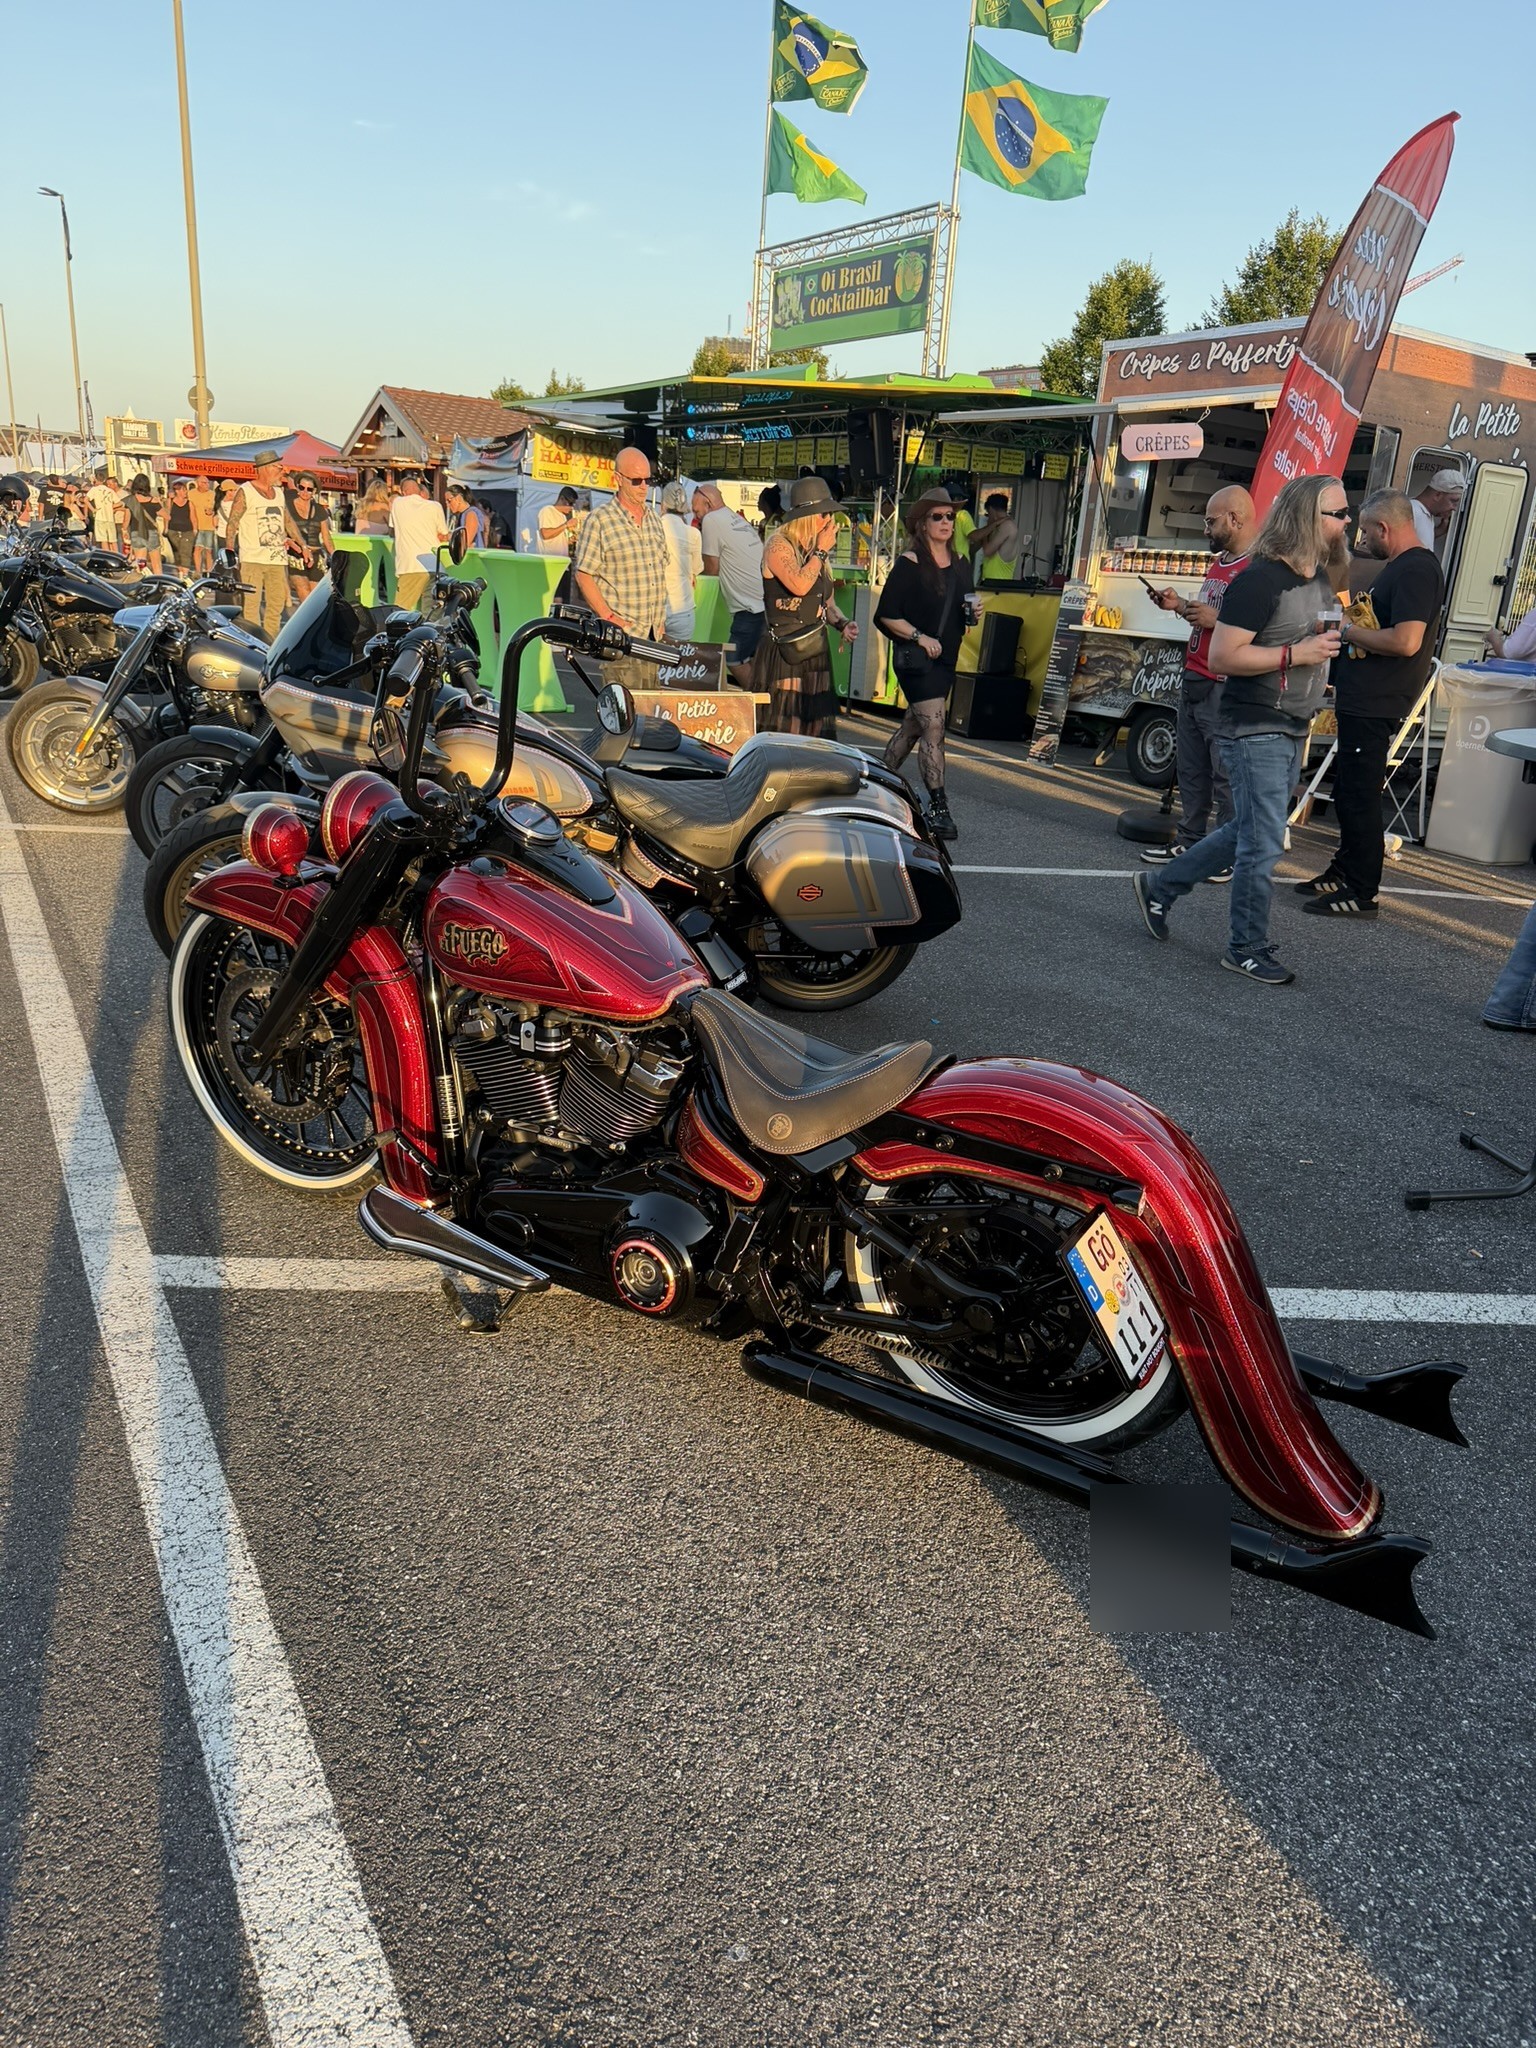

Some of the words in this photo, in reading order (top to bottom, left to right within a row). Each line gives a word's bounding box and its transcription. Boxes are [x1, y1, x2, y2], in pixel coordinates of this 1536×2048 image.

[821, 269, 836, 293] Oi
[839, 260, 882, 289] Brasil
[810, 285, 891, 318] Cocktailbar
[1119, 350, 1182, 380] Crêpes
[1187, 352, 1201, 371] &
[1206, 335, 1299, 374] Poffertj
[210, 424, 240, 441] König
[241, 425, 284, 440] Pilsener
[1449, 402, 1471, 440] La
[1474, 402, 1522, 439] Petite
[540, 432, 619, 458] COCKTA
[1135, 432, 1191, 452] CRÊPES
[540, 449, 592, 469] HAPPY
[580, 469, 599, 484] 7€
[1143, 650, 1154, 666] La
[677, 698, 718, 720] Petite
[444, 924, 508, 957] FUEGO
[1240, 958, 1259, 973] N
[313, 1061, 323, 1097] brembo
[1087, 1225, 1116, 1272] GÖ
[1087, 1284, 1099, 1302] D
